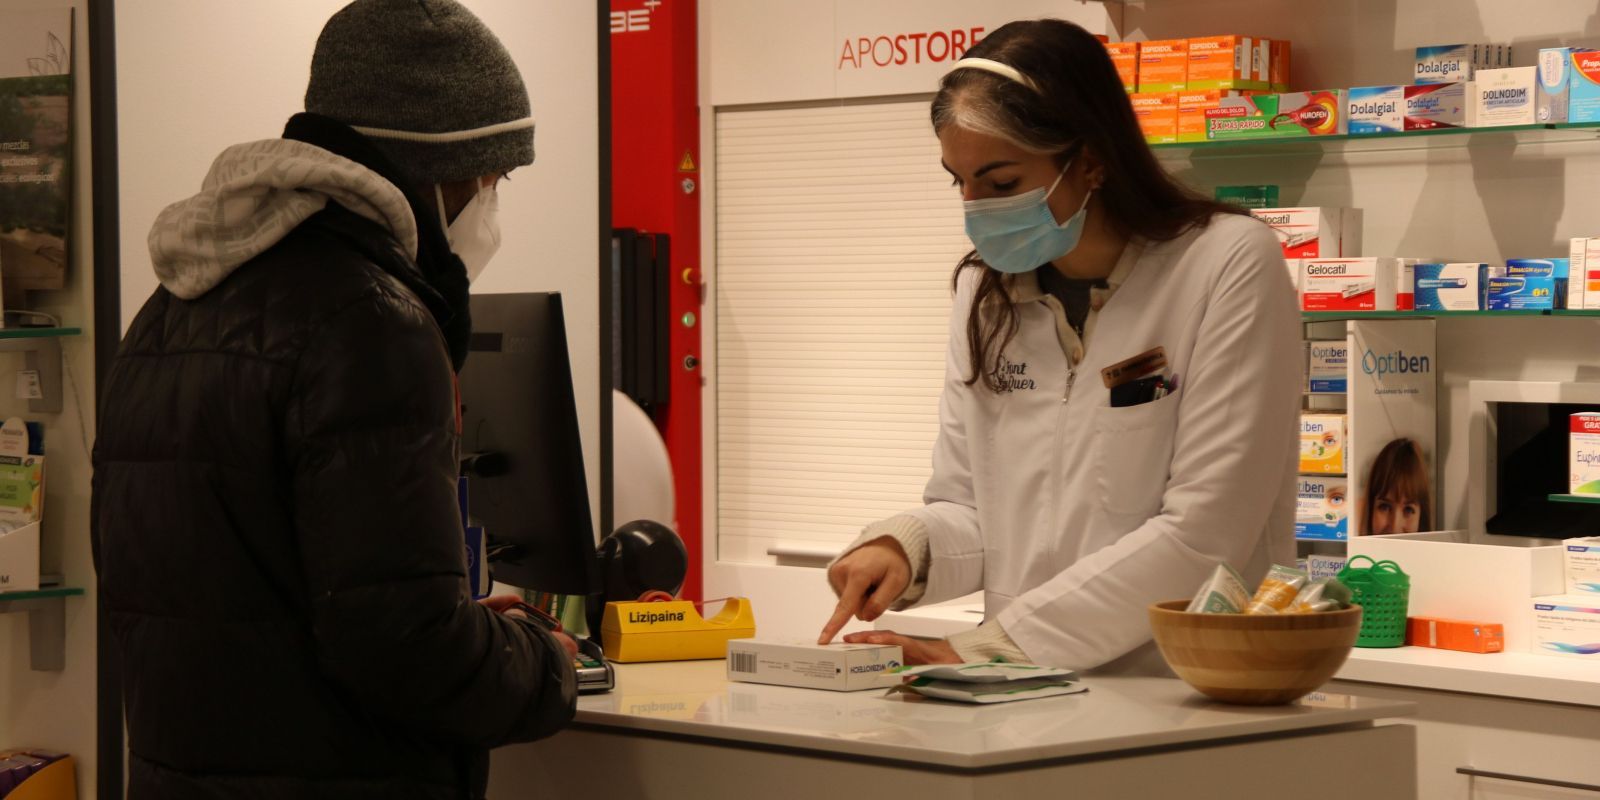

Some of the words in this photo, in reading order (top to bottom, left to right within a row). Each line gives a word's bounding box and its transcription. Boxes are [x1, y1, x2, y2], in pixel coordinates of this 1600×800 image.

[1417, 60, 1460, 75] Dolalgial
[1483, 88, 1526, 100] DOLNODIM
[1350, 101, 1396, 117] Dolalgial
[1407, 98, 1440, 110] Dolalgial
[1300, 110, 1328, 119] NUROFEN
[1307, 264, 1347, 275] Gelocatil
[1362, 349, 1430, 380] Optiben
[629, 610, 684, 625] Lizipaina
